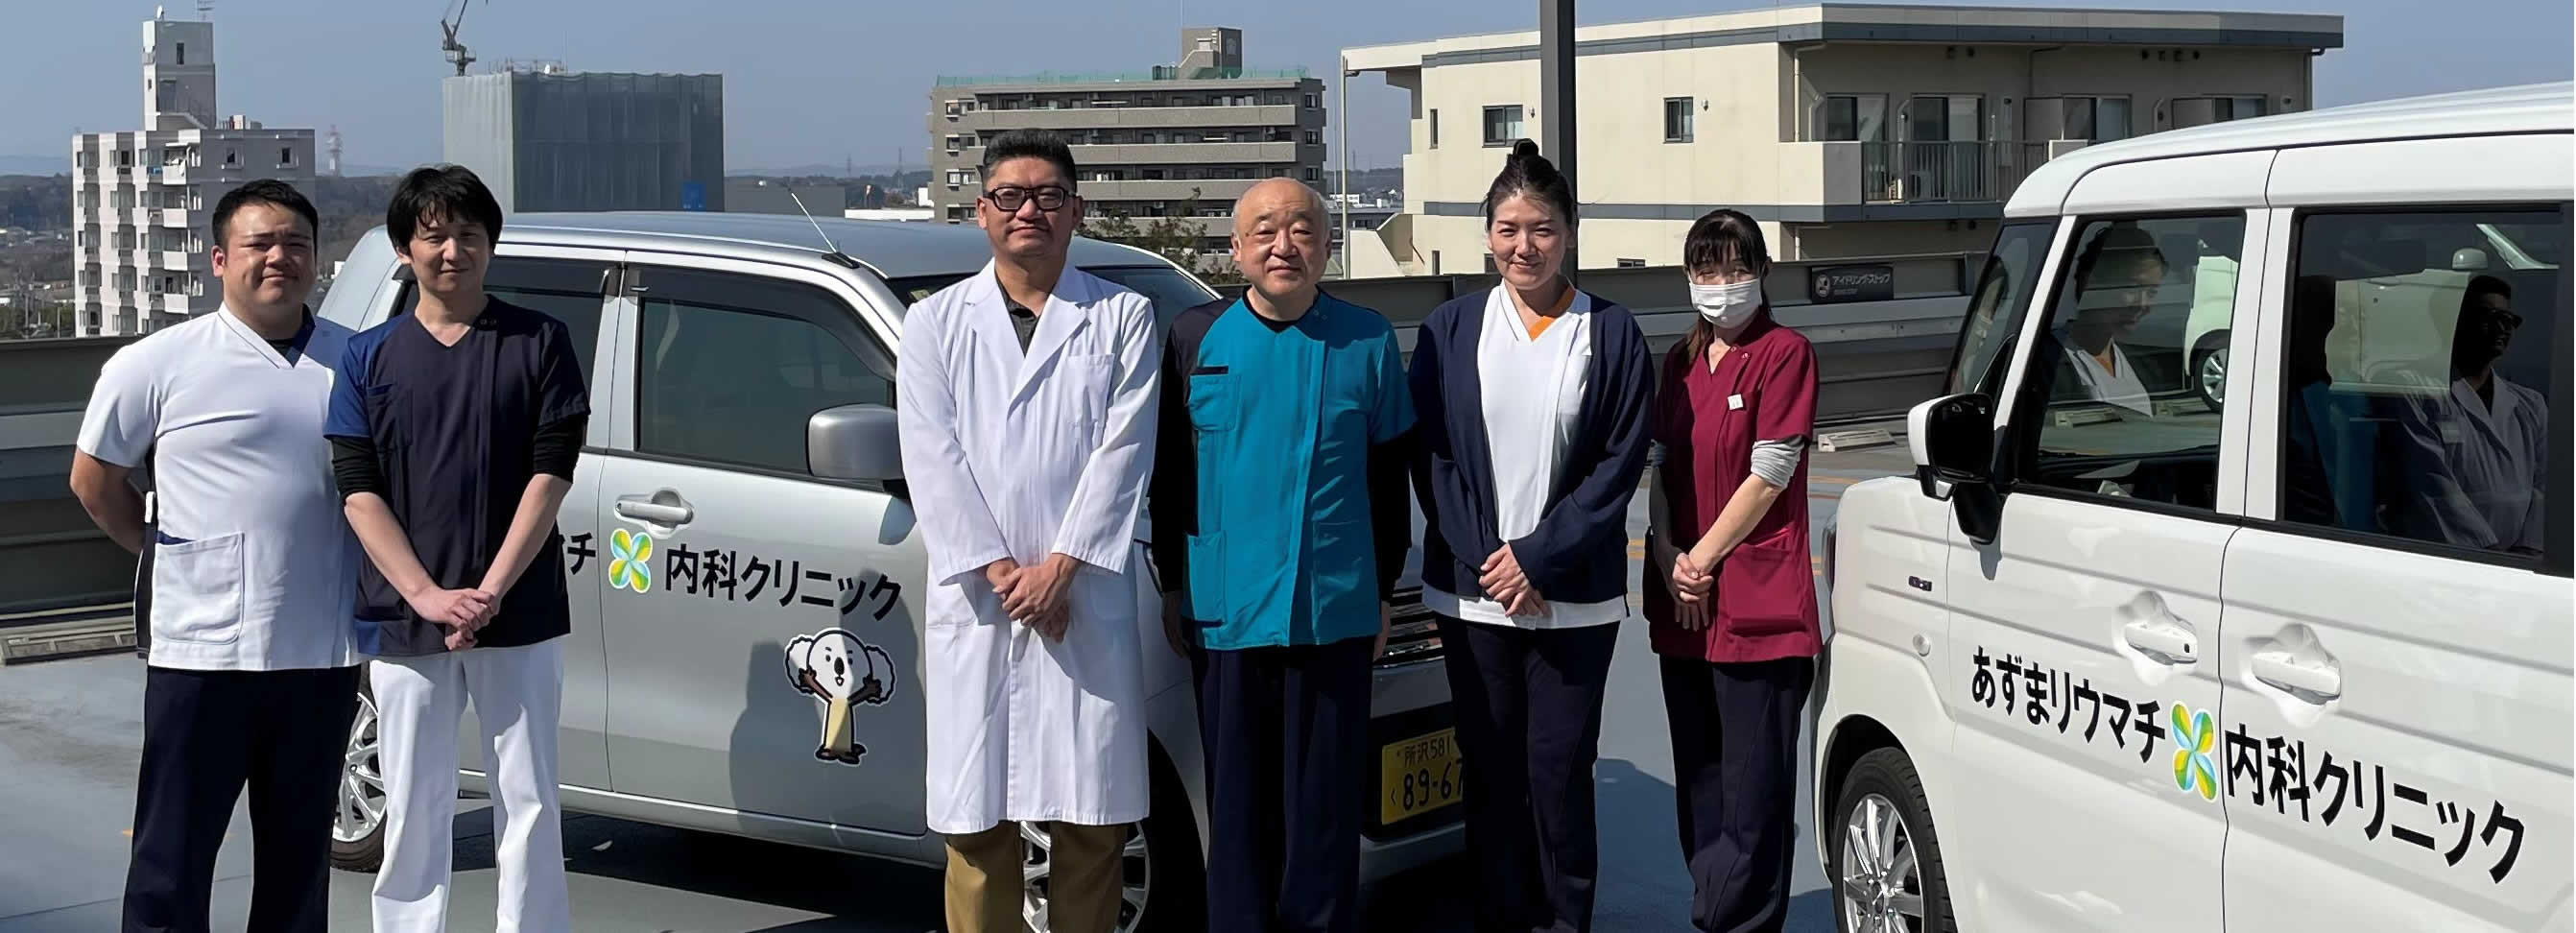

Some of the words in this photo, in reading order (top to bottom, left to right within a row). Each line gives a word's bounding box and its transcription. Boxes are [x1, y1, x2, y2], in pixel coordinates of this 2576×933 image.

[561, 532, 596, 575] チ
[665, 543, 902, 621] 内科クリニック
[1970, 646, 2166, 763] あずまリウマチ
[2224, 723, 2525, 884] 内科クリニック
